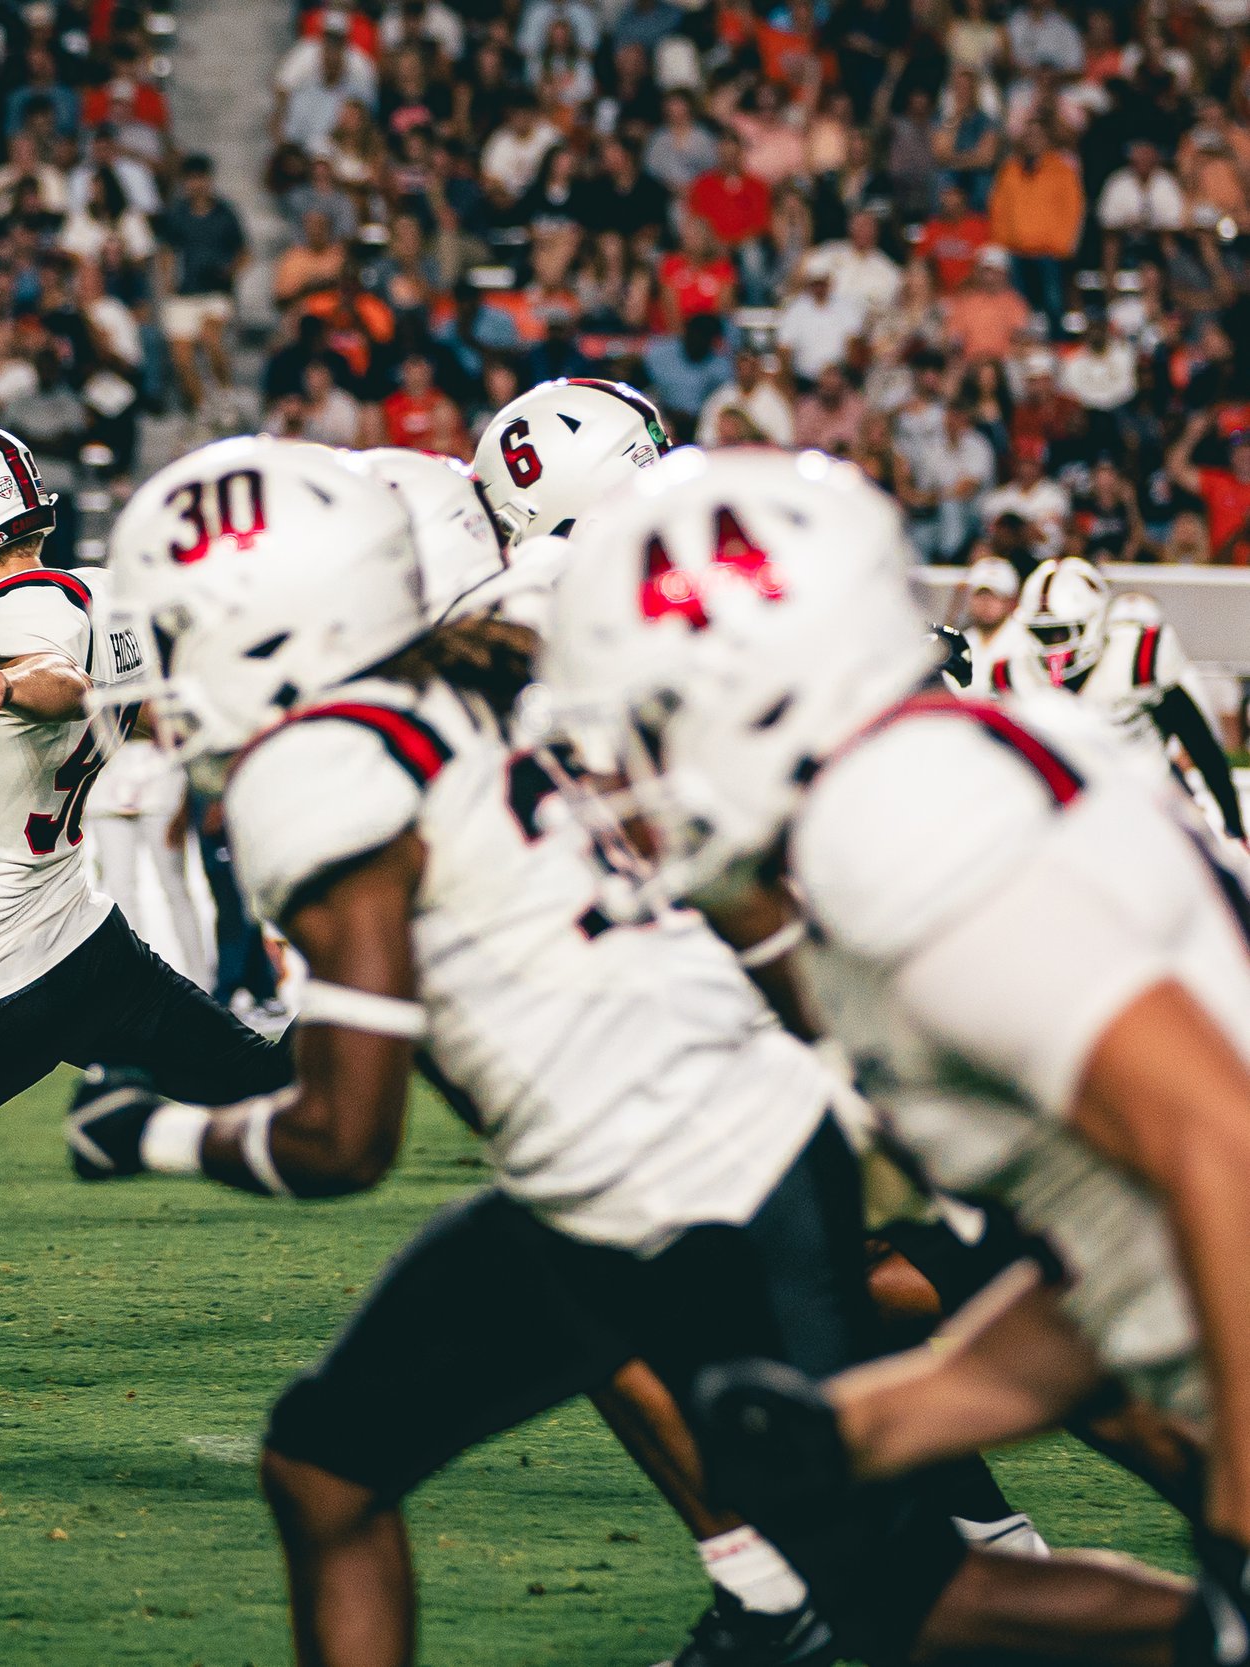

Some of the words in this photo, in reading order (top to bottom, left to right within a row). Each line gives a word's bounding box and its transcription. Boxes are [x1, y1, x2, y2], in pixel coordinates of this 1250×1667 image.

[500, 419, 543, 489] 6
[163, 469, 265, 565] 30
[642, 505, 783, 632] 44
